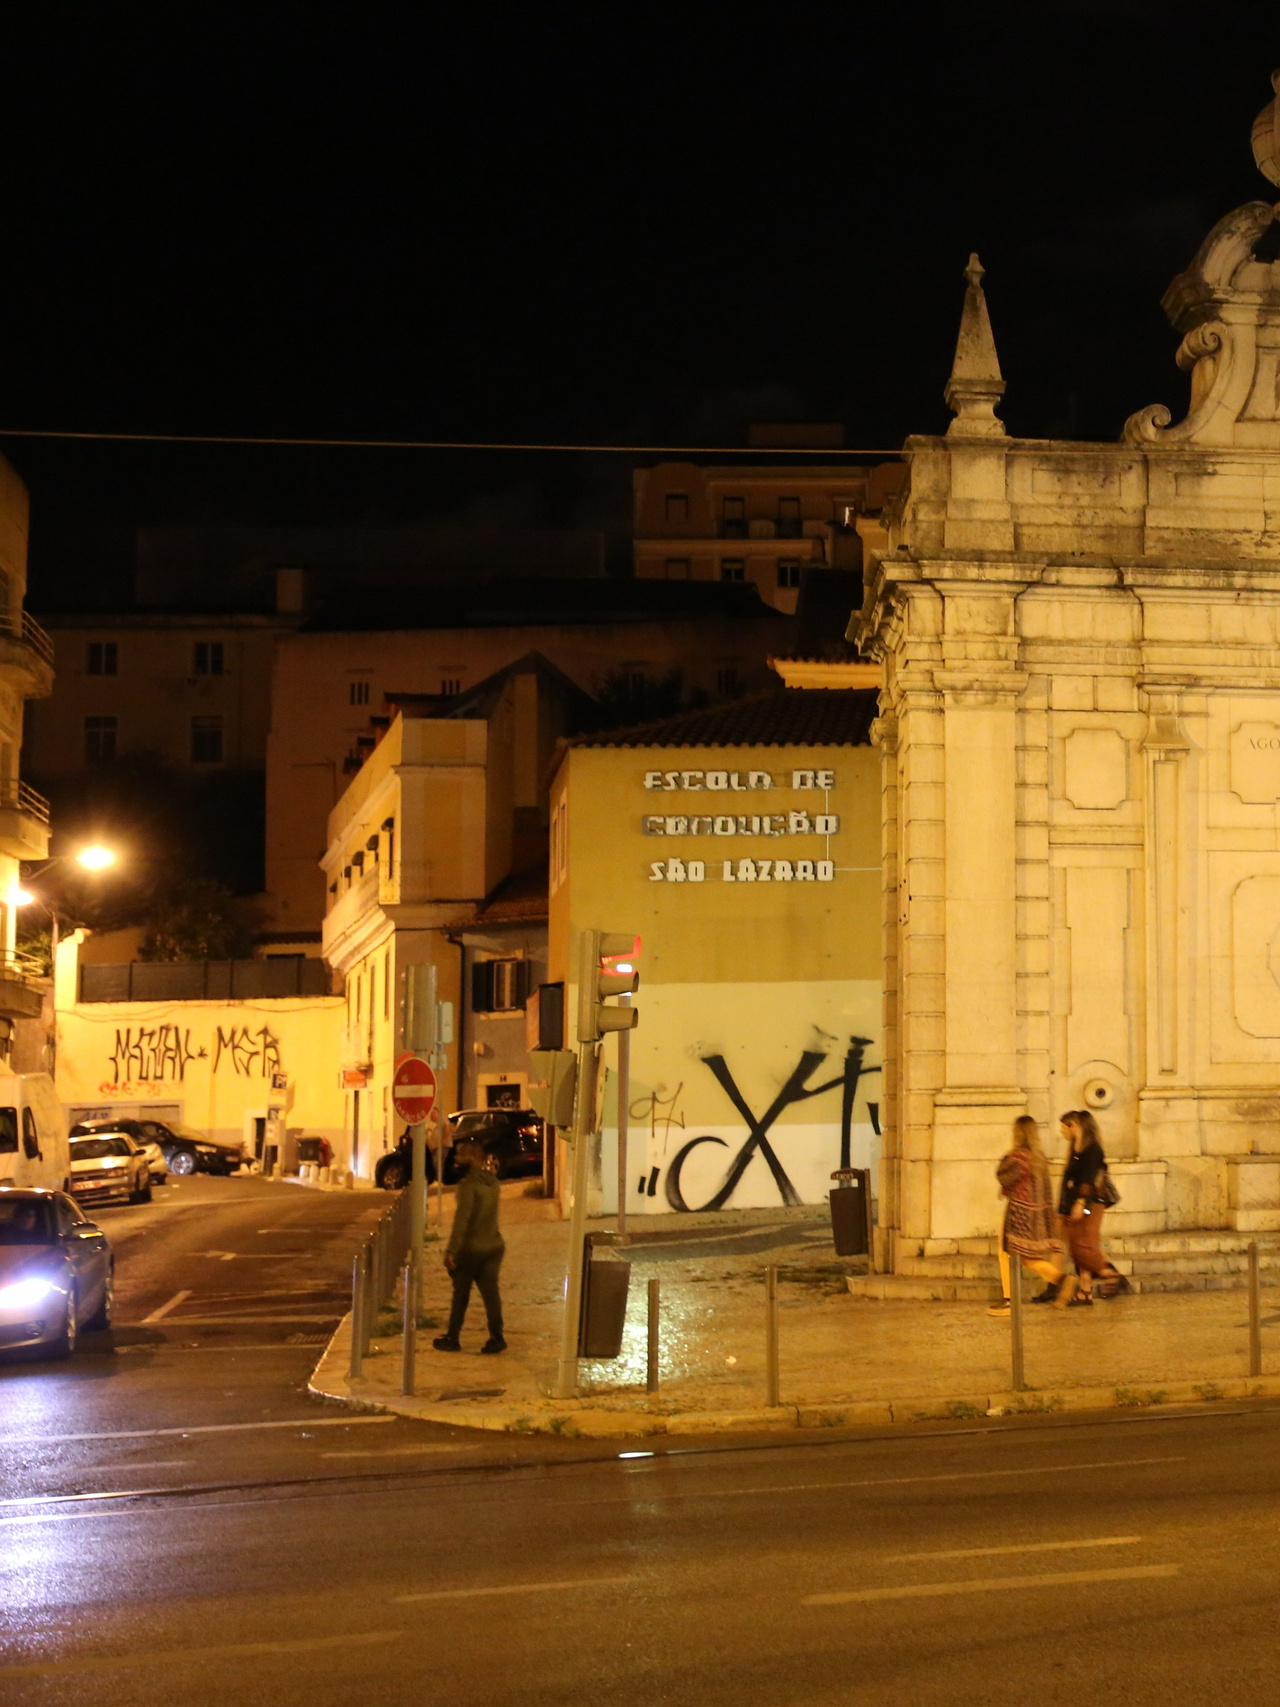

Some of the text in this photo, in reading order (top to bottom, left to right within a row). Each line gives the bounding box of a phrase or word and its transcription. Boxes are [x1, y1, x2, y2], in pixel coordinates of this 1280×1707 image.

[644, 771, 835, 791] ESCOLA DE
[649, 858, 834, 882] SÃO LÁZARO
